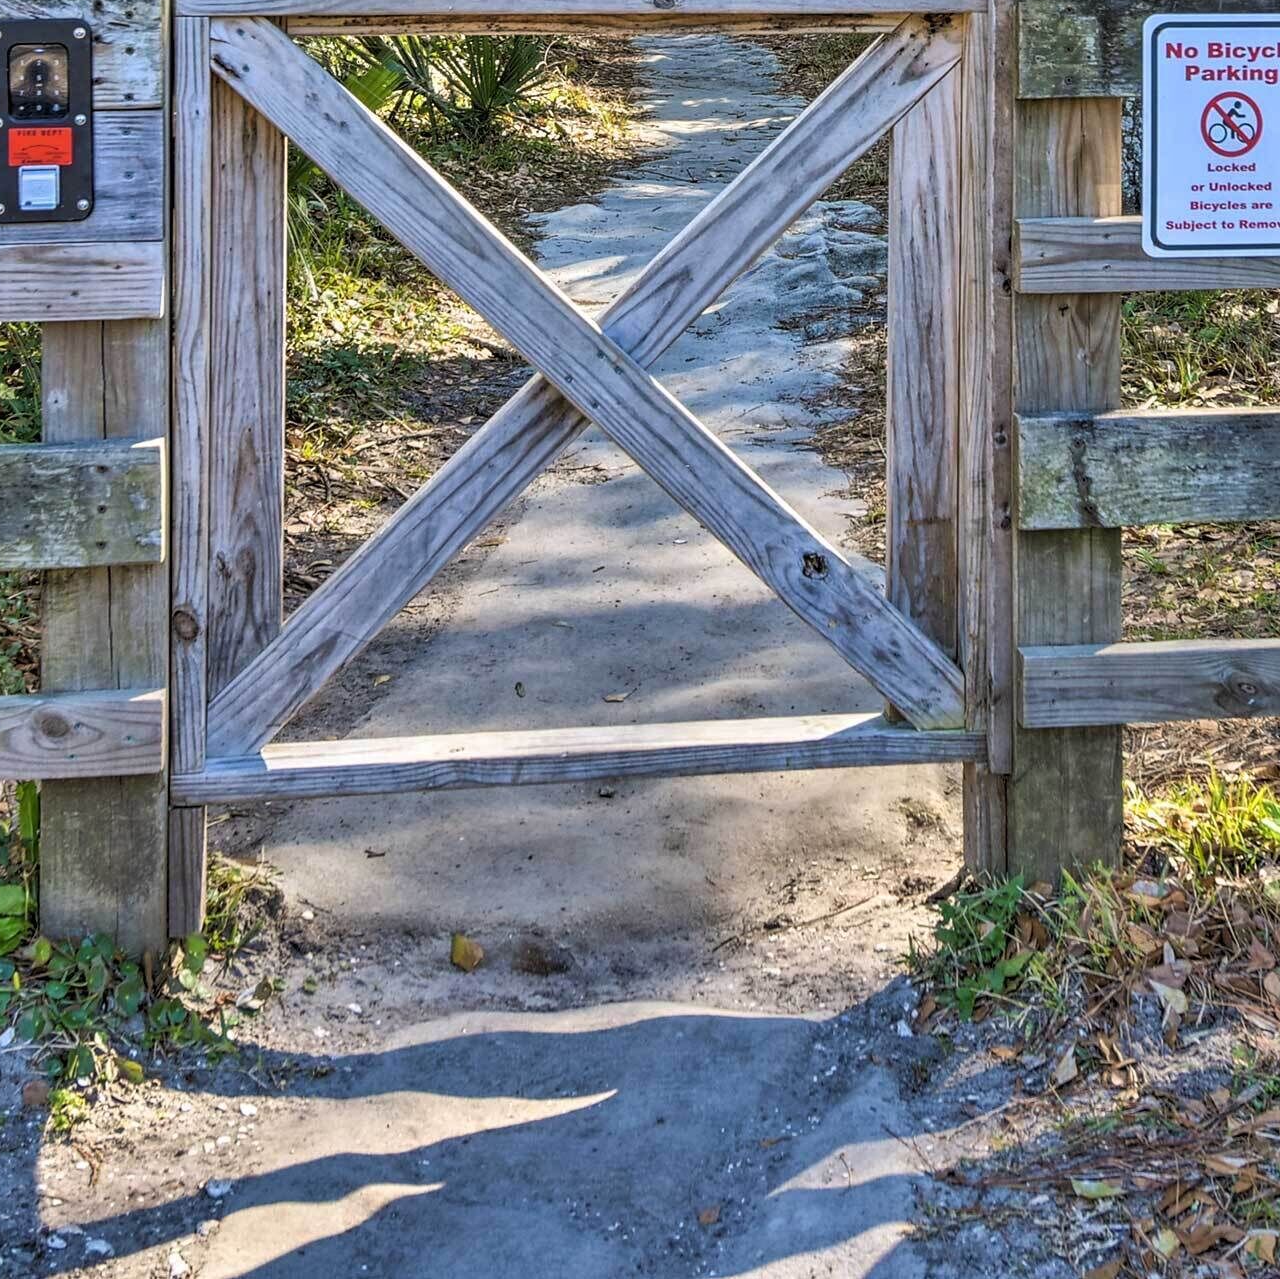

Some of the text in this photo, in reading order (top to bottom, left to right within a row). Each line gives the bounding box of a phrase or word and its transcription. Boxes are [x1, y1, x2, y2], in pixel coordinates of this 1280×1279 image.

[1165, 42, 1199, 59] No
[1185, 64, 1279, 85] Parking
[1207, 162, 1256, 173] Locked
[1190, 181, 1272, 192] or Unlocked
[1190, 200, 1273, 213] Bicycles are
[1165, 220, 1217, 232] Subject
[1221, 220, 1235, 230] to
